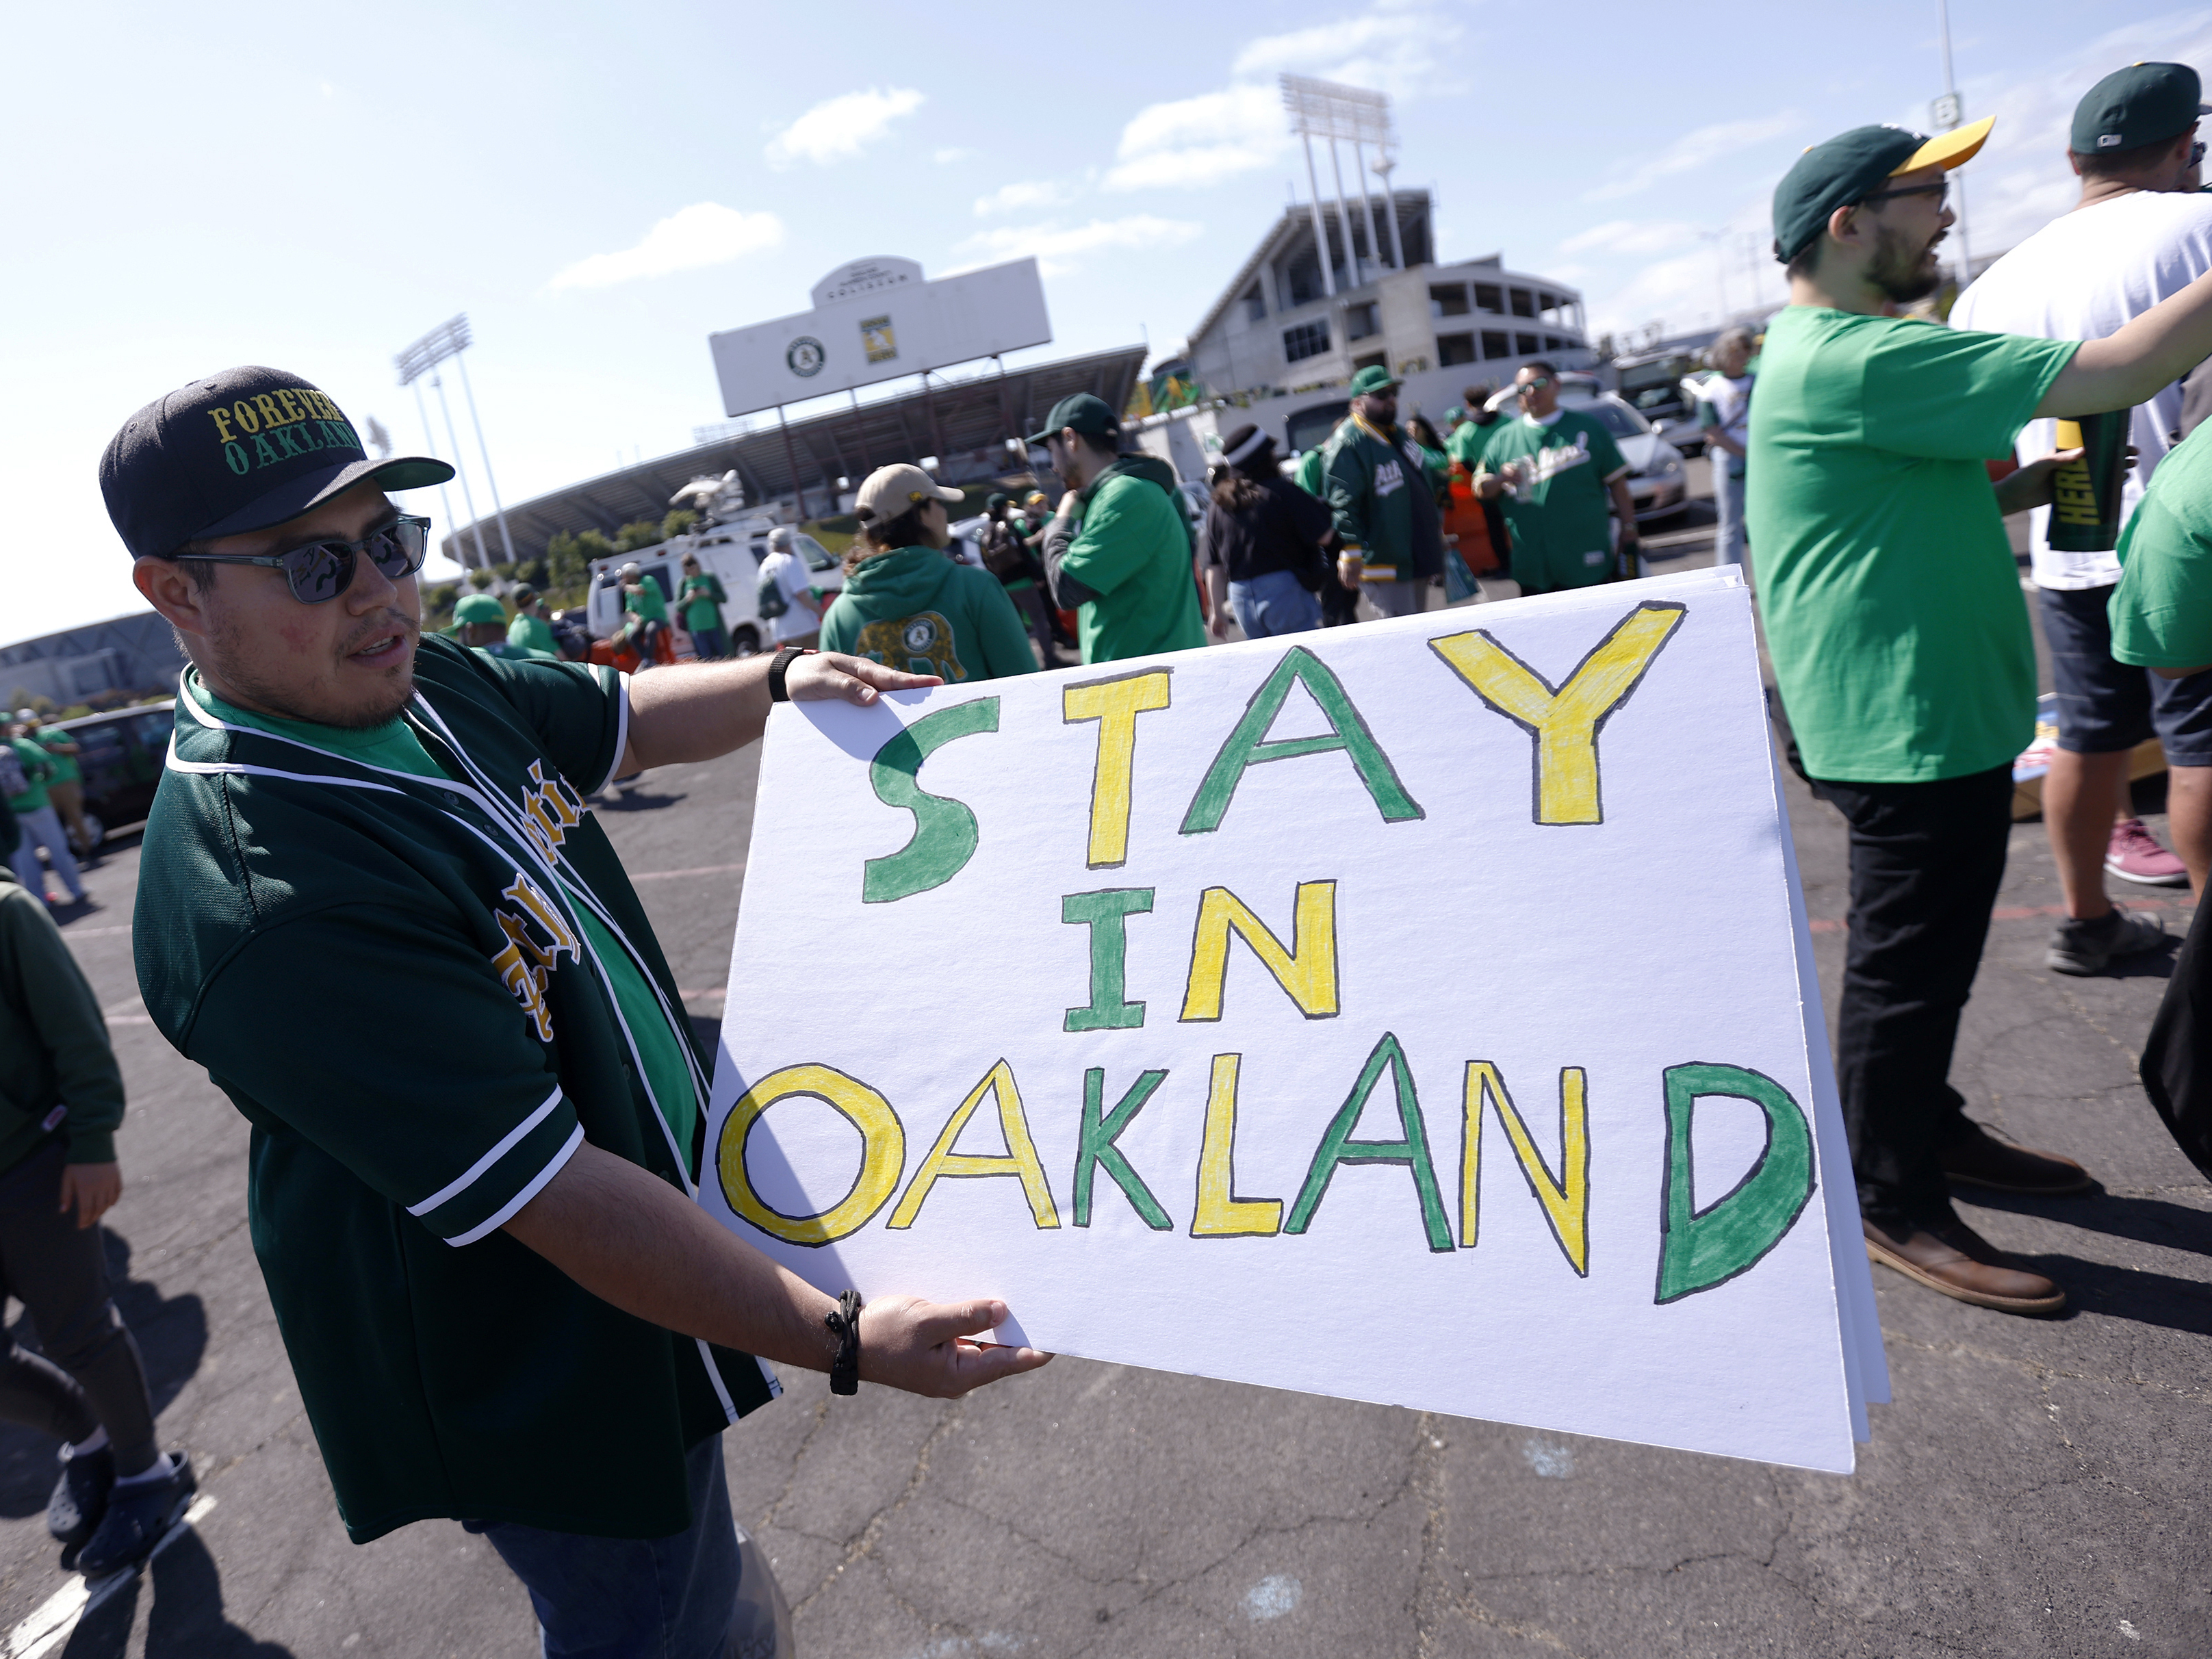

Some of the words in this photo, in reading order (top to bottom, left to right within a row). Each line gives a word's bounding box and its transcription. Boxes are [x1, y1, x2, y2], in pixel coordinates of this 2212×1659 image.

[207, 388, 344, 443] FOREVER
[862, 601, 1686, 904] STAY
[1062, 879, 1340, 1032] IN
[717, 1031, 1816, 1306] OAKLAND
